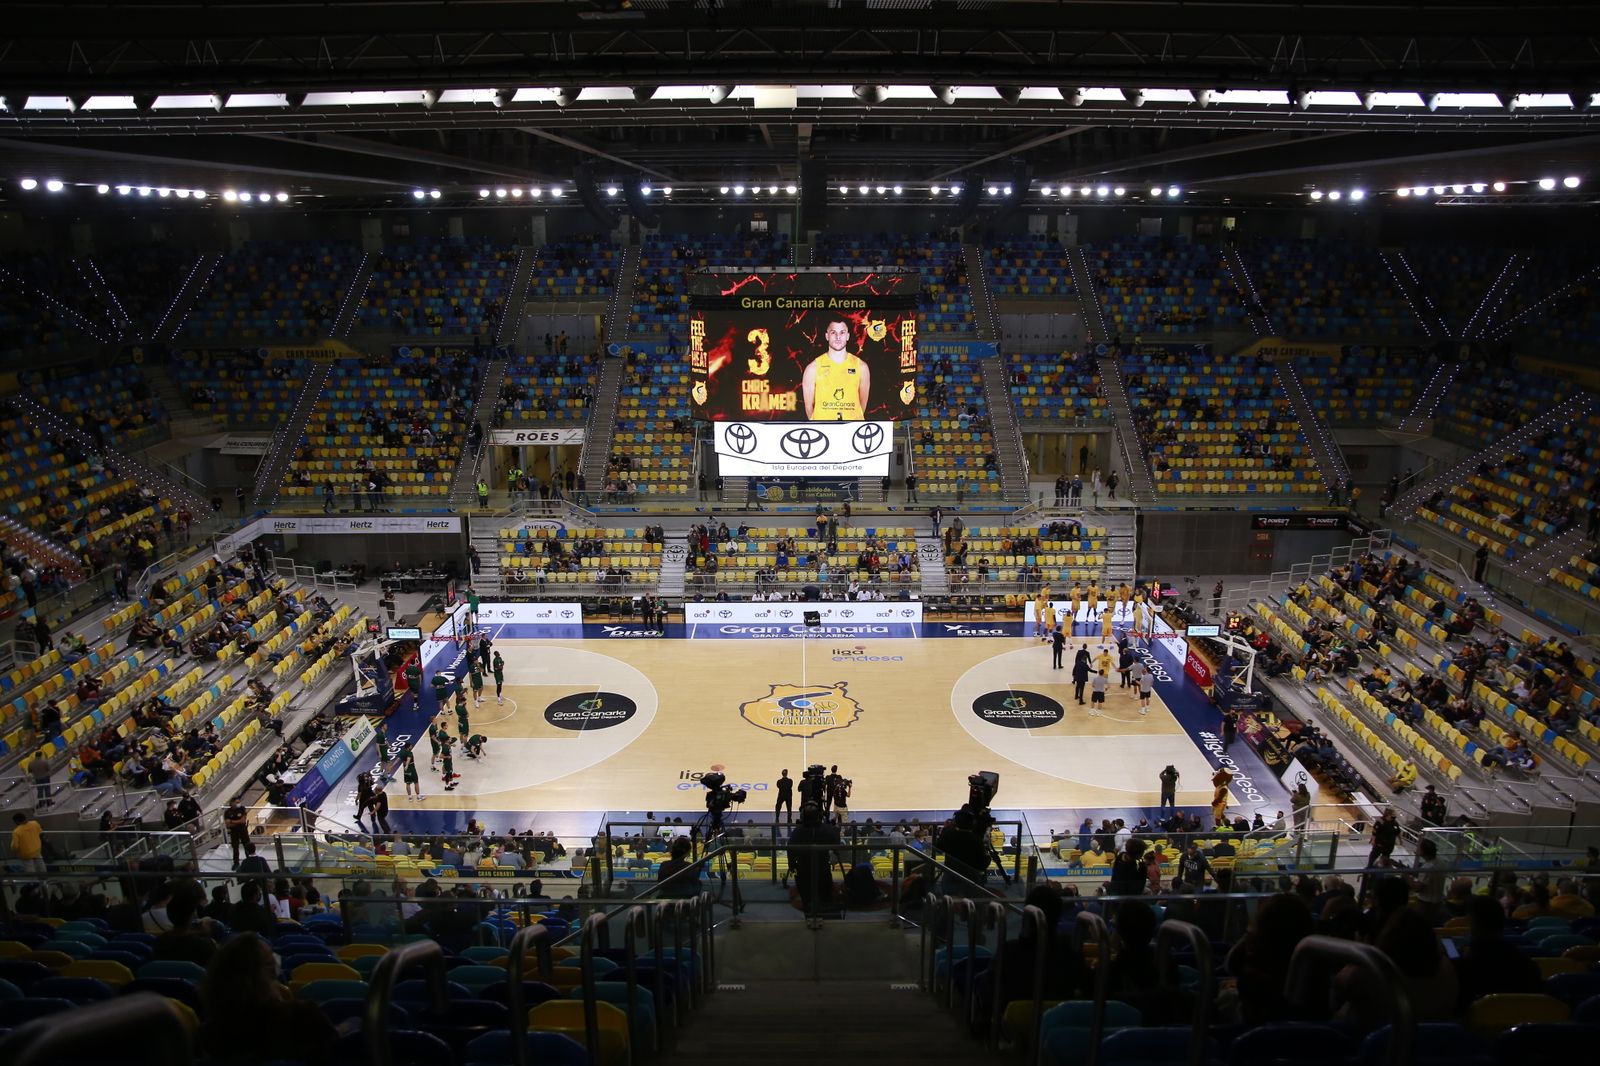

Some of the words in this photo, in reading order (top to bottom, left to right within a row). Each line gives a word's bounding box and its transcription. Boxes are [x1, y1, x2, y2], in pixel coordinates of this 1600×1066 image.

[741, 297, 772, 309] Gran
[776, 297, 825, 309] Canaria
[828, 297, 867, 309] Arena
[691, 320, 706, 336] FEEL
[902, 320, 916, 336] FEEL
[691, 336, 703, 351] THE
[901, 335, 913, 351] THE
[747, 328, 770, 376] 3
[691, 351, 707, 367] HEAT
[900, 350, 917, 367] HEAT
[741, 380, 769, 393] CHRIS
[516, 432, 559, 441] ROES
[274, 521, 296, 529] Hertz
[350, 520, 373, 529] Hertz
[427, 520, 450, 528] Hertz
[719, 624, 781, 634] Gran
[788, 624, 889, 634] Canaria
[783, 708, 821, 717] GRAN
[772, 716, 836, 725] CANARIA
[676, 782, 769, 791] enesa
[478, 870, 495, 878] GRAN
[496, 870, 515, 878] CANARIA
